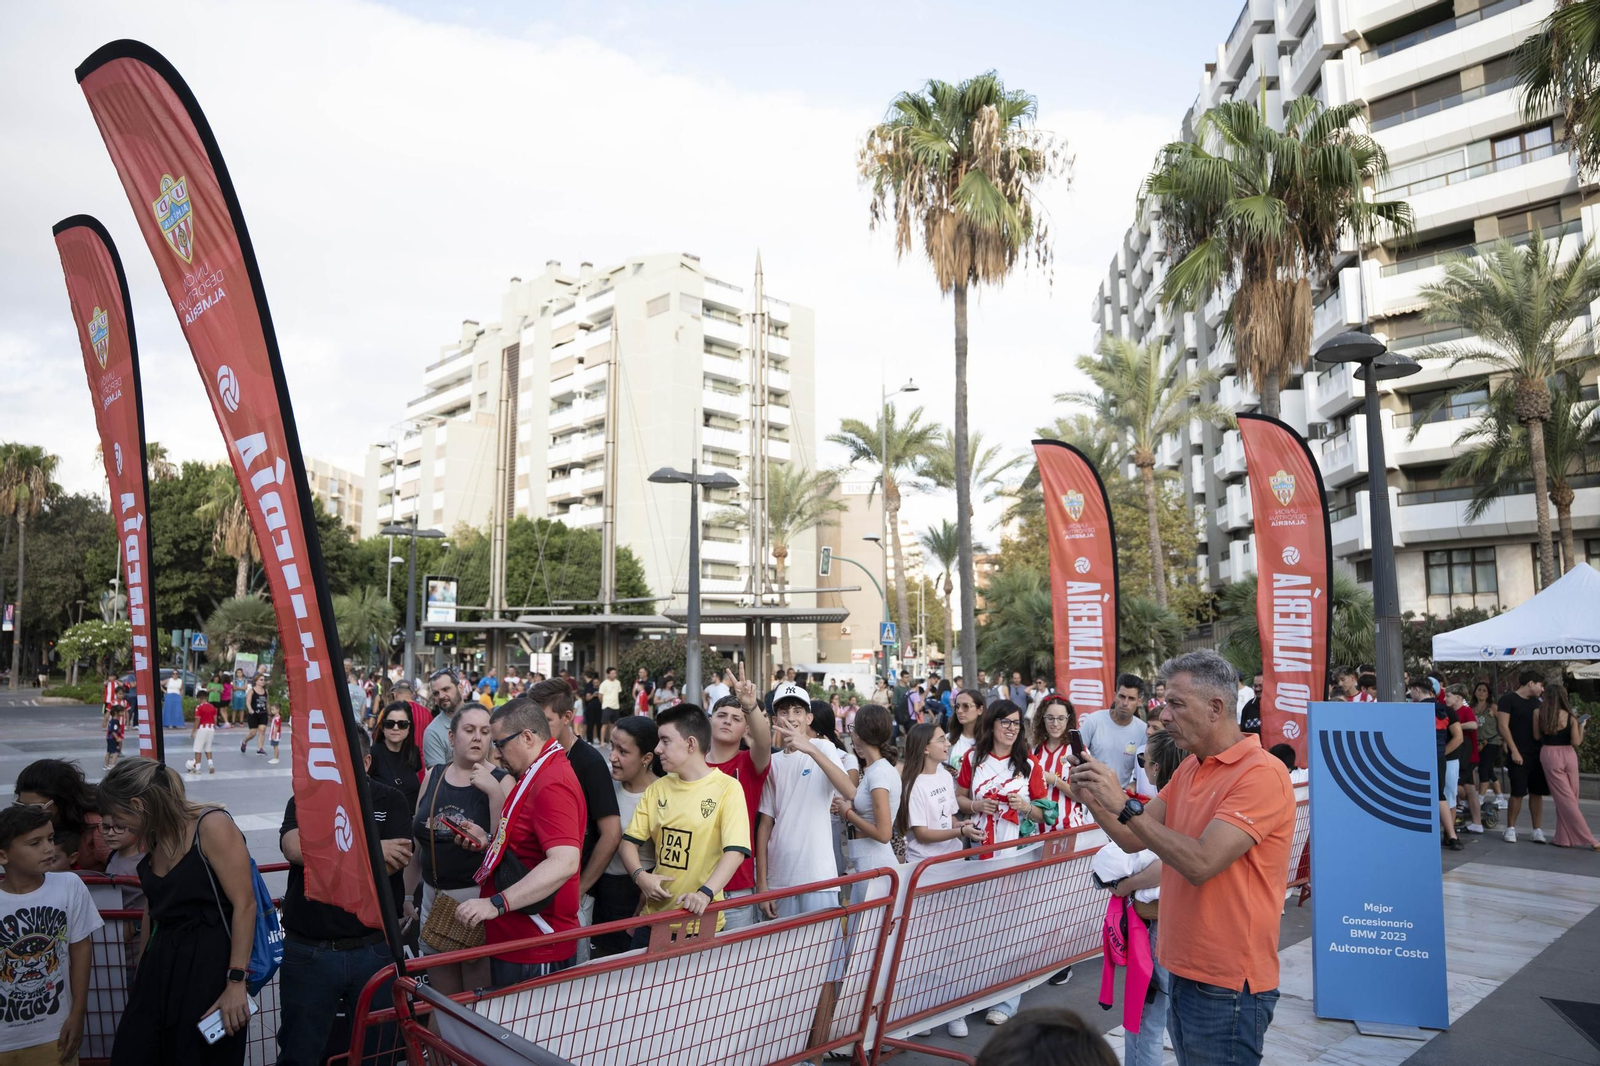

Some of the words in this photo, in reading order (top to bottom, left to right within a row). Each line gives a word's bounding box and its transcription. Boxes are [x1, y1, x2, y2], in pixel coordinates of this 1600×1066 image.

[1364, 902, 1393, 914] Mejor
[1342, 915, 1414, 929] Concesionario
[1350, 929, 1377, 939] BMW
[1380, 931, 1407, 942] 2023
[1329, 942, 1393, 956] Automotor
[1394, 946, 1429, 959] Costa
